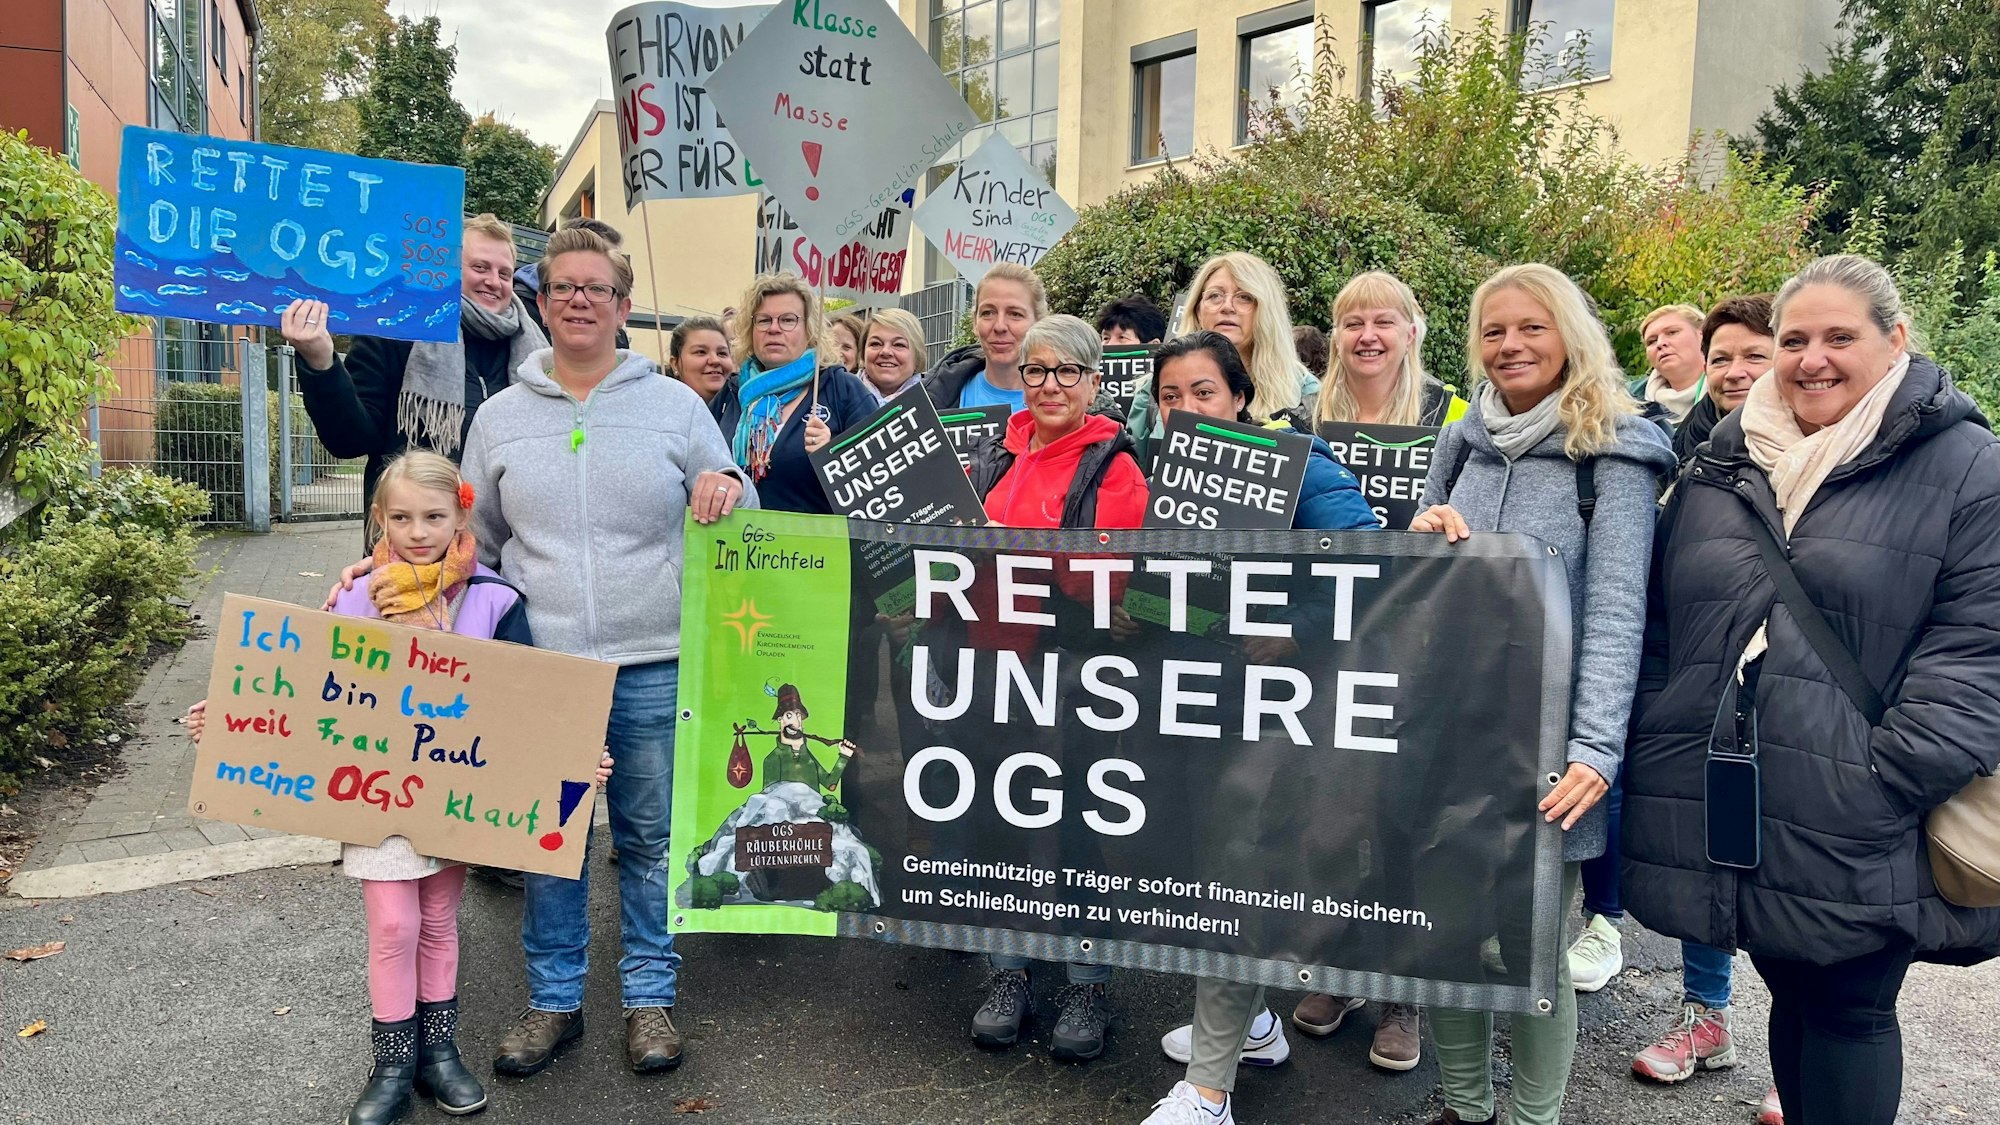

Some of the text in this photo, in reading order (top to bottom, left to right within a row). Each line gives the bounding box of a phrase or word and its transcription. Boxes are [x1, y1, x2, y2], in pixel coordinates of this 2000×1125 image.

[792, 0, 878, 38] Klasse
[799, 45, 872, 86] statt
[675, 82, 706, 131] IST
[773, 92, 848, 131] Masse
[147, 142, 383, 214] RETTET
[679, 138, 737, 192] FÜR
[953, 166, 1050, 209] Kinder
[148, 199, 388, 279] DIE OGS
[400, 213, 449, 239] SOS
[1031, 211, 1057, 226] OGS
[401, 239, 449, 266] SOS
[756, 236, 782, 276] IM
[944, 228, 1048, 267] MEHRWERT
[400, 262, 448, 289] SOS
[1098, 358, 1154, 376] ETTET
[823, 406, 918, 484] RETTET
[833, 428, 942, 507] UNSERE
[1168, 431, 1290, 479] RETTET
[1329, 441, 1434, 470] RETTE
[1161, 462, 1289, 515] UNSERE
[1153, 495, 1219, 530] OGS
[714, 539, 739, 571] Im
[746, 543, 825, 571] Kirchfeld
[912, 549, 1381, 642] RETTET
[239, 610, 472, 683] Ich bin hier,
[232, 664, 471, 720] ich bin laut
[910, 645, 1400, 755] UNSERE
[224, 708, 488, 768] weil Frau Paul
[216, 761, 317, 803] meine
[327, 764, 425, 813] OGS
[903, 746, 1147, 837] OGS
[745, 838, 824, 853] RÄUBERHÖHLE
[772, 824, 794, 837] OGS
[749, 853, 821, 867] LÜTZENKIRCHEN
[901, 888, 1240, 937] um Schließungen zu verhindern!
[902, 854, 1433, 932] Gemeinnützige Träger sofort finanziell absichern,
